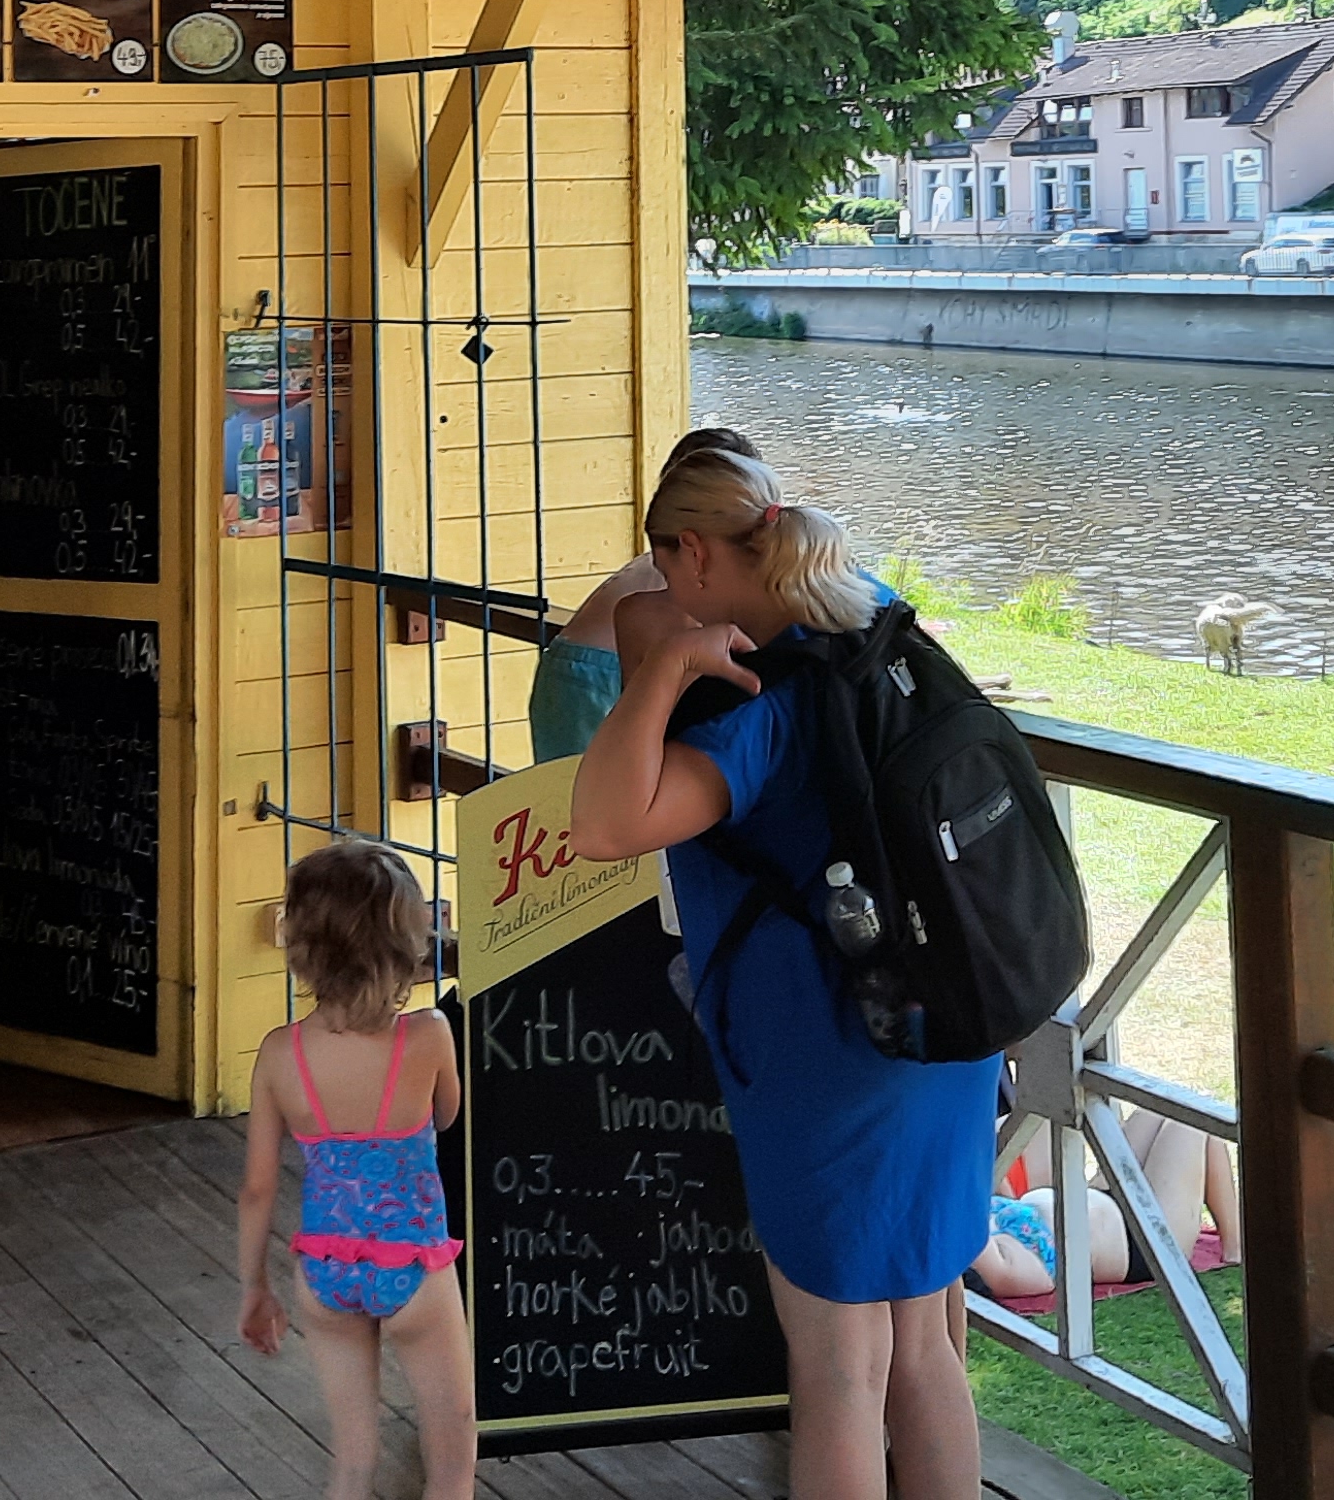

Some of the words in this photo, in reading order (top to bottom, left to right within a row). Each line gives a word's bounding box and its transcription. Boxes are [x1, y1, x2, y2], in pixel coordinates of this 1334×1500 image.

[493, 806, 579, 908] Ki
[481, 987, 674, 1072] Kitlova
[502, 1209, 605, 1261] máta
[505, 1262, 619, 1325] horké
[625, 1257, 749, 1337] jablko
[500, 1321, 711, 1398] grapefruit
